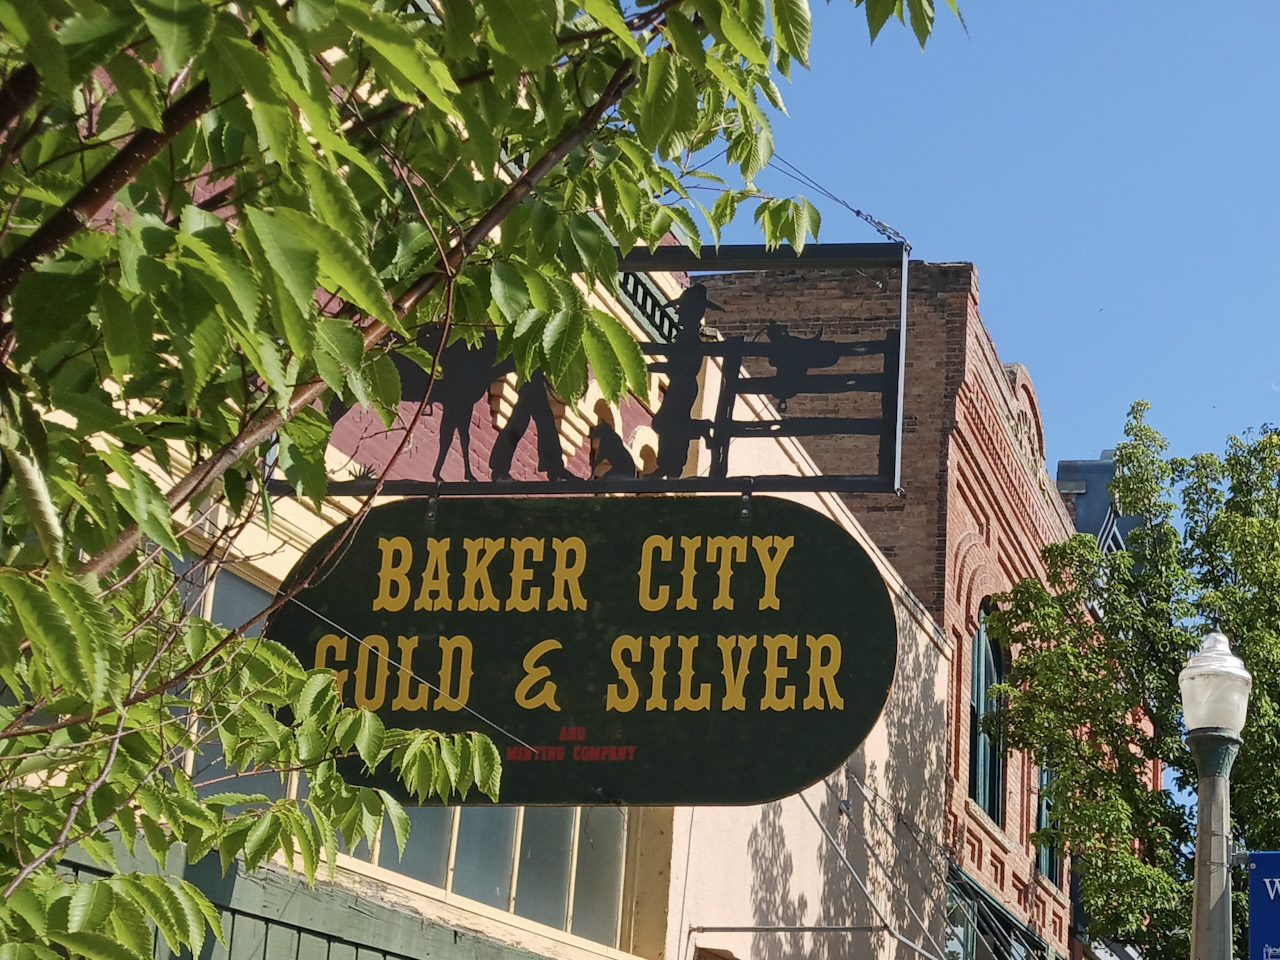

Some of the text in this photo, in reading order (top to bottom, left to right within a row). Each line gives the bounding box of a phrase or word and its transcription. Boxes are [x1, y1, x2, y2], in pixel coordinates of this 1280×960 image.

[371, 534, 796, 612] BAKER CITY
[314, 633, 845, 713] GOLD & SILVER
[506, 745, 637, 761] MINTING COMPANY
[559, 726, 587, 741] AND
